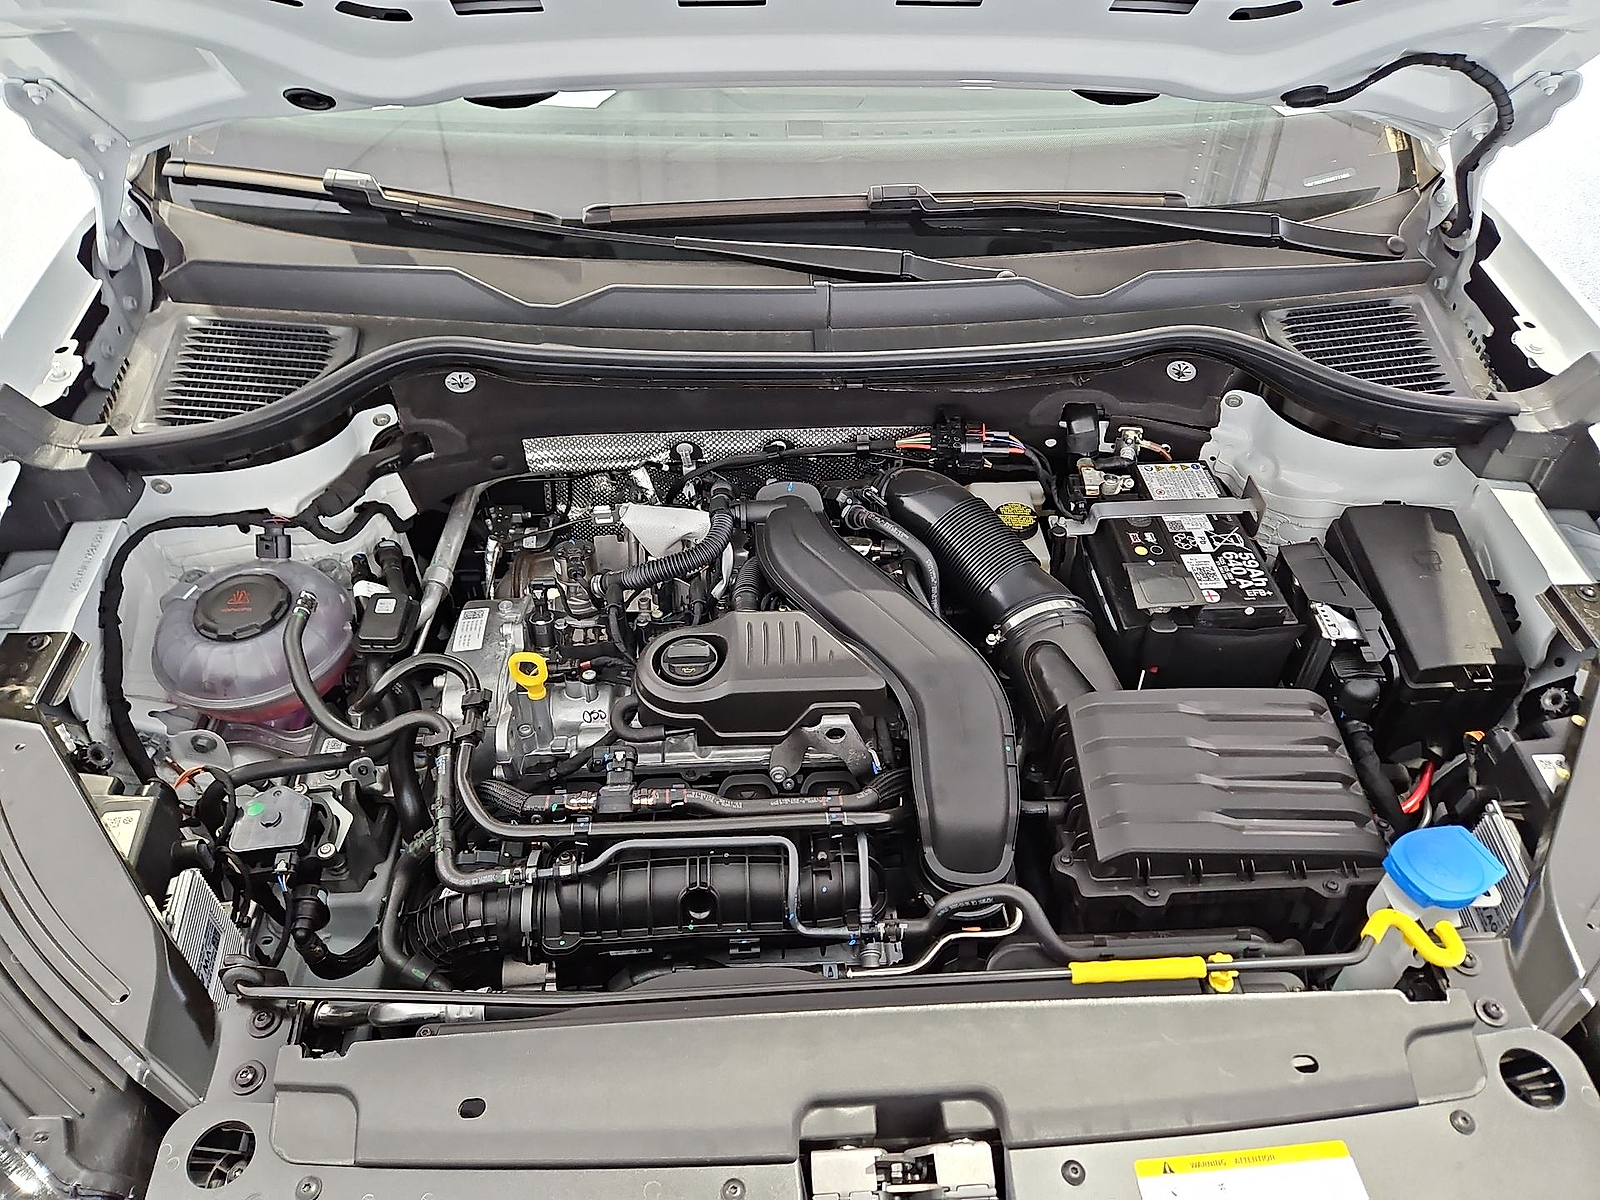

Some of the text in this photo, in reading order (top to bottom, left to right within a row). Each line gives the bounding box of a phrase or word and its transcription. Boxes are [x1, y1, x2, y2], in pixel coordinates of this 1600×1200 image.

[1197, 536, 1207, 545] Pb
[1222, 551, 1248, 576] 640
[1235, 577, 1254, 590] A
[1238, 552, 1269, 587] 59Ah
[1189, 1154, 1276, 1169] WARNING ATTENTION
